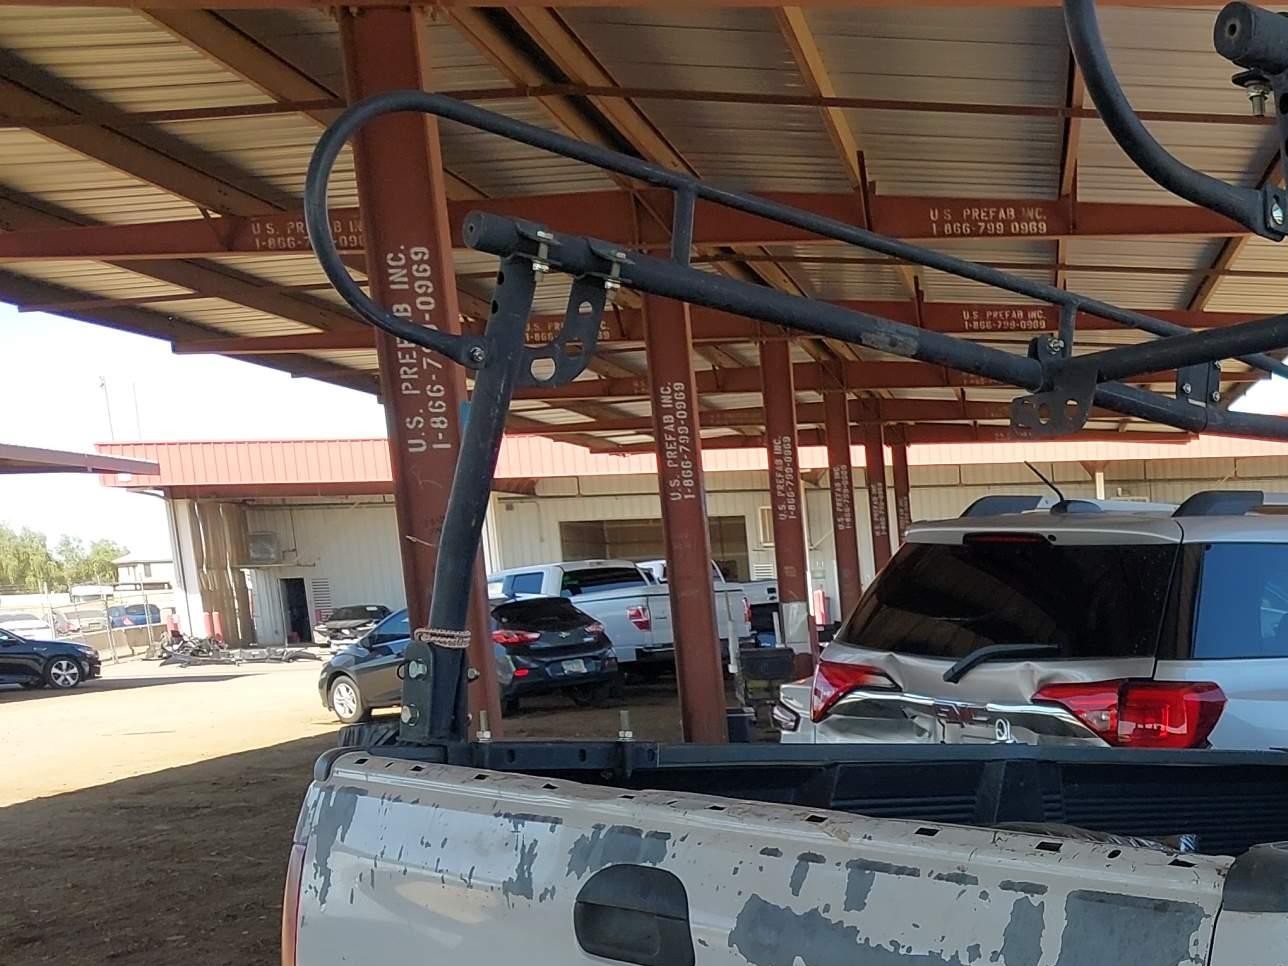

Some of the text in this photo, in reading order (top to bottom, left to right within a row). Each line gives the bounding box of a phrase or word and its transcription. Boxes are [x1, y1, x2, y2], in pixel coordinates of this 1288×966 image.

[963, 208, 1015, 221] PREFAB
[386, 245, 427, 453] U.S. PREFB INC.
[410, 246, 451, 449] 1-866-7-0969
[660, 382, 682, 501] U.S. PREFAB INC.
[673, 382, 696, 499] 1-866-799-0969
